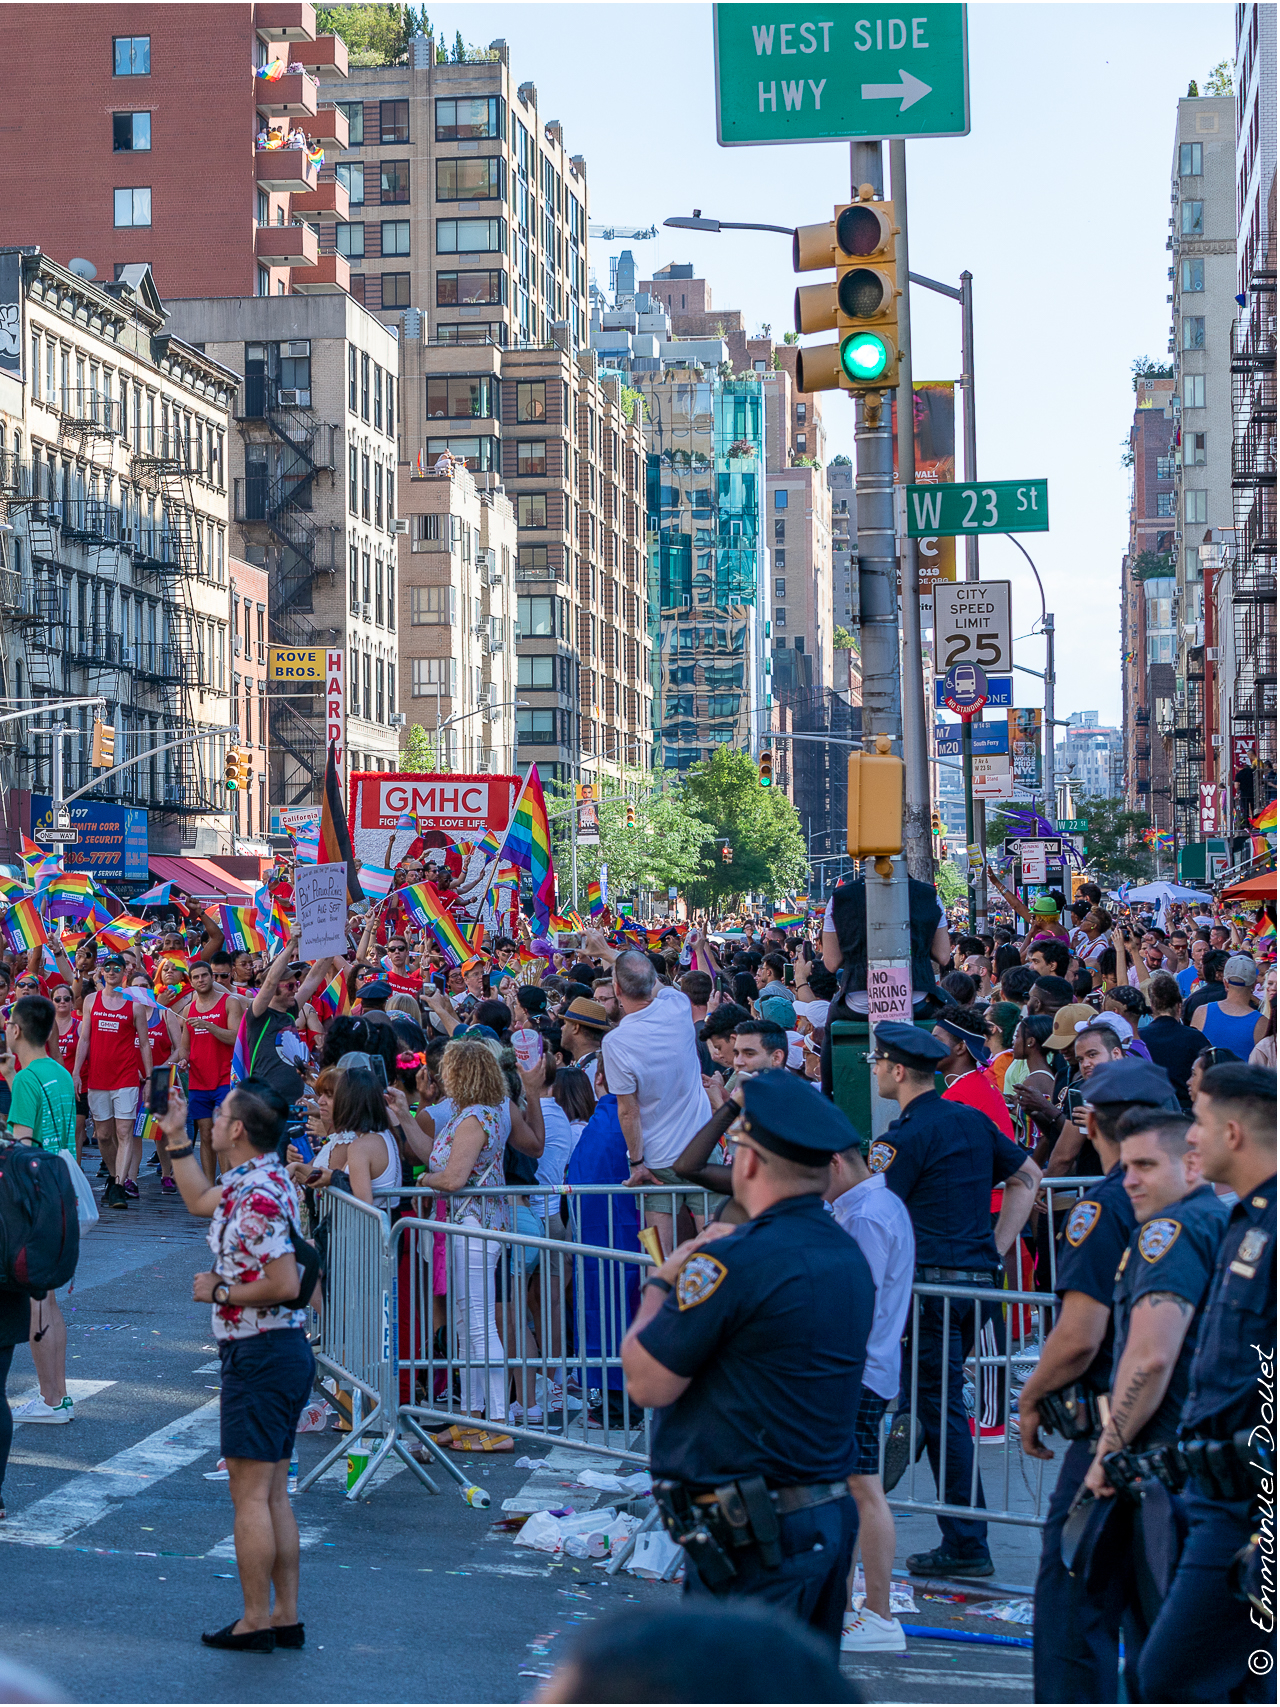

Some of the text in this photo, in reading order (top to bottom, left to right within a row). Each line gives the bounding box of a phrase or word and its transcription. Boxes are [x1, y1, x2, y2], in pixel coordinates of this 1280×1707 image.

[751, 17, 930, 56] WEST SIDE
[758, 78, 827, 113] HWY
[912, 486, 1038, 530] W 23 St
[918, 567, 940, 576] 019
[956, 588, 988, 600] CITY
[950, 602, 995, 615] SPEED
[955, 617, 991, 629] LIMIT
[944, 632, 1002, 667] 25
[276, 652, 317, 662] KOVE
[275, 667, 321, 677] BROS.
[947, 696, 985, 713] NO STANDING
[986, 693, 1008, 704] ONE
[935, 726, 951, 738] M7
[938, 741, 959, 754] M20
[986, 739, 999, 747] Ferry
[1013, 766, 1036, 775] NYC
[385, 786, 483, 814] GMHC
[70, 808, 89, 818] 197
[1200, 784, 1217, 832] WINE
[282, 812, 318, 824] California
[379, 818, 488, 828] FIGH IDS. LOVE LIFE.
[99, 822, 120, 831] CORP.
[1058, 821, 1066, 830] W
[1068, 821, 1078, 829] 22
[85, 835, 123, 845] SECURITY
[63, 851, 122, 865] 206-7777
[14, 929, 26, 950] GMHC
[872, 971, 888, 985] NO
[869, 984, 907, 999] ARKING
[870, 999, 906, 1014] UNDAY
